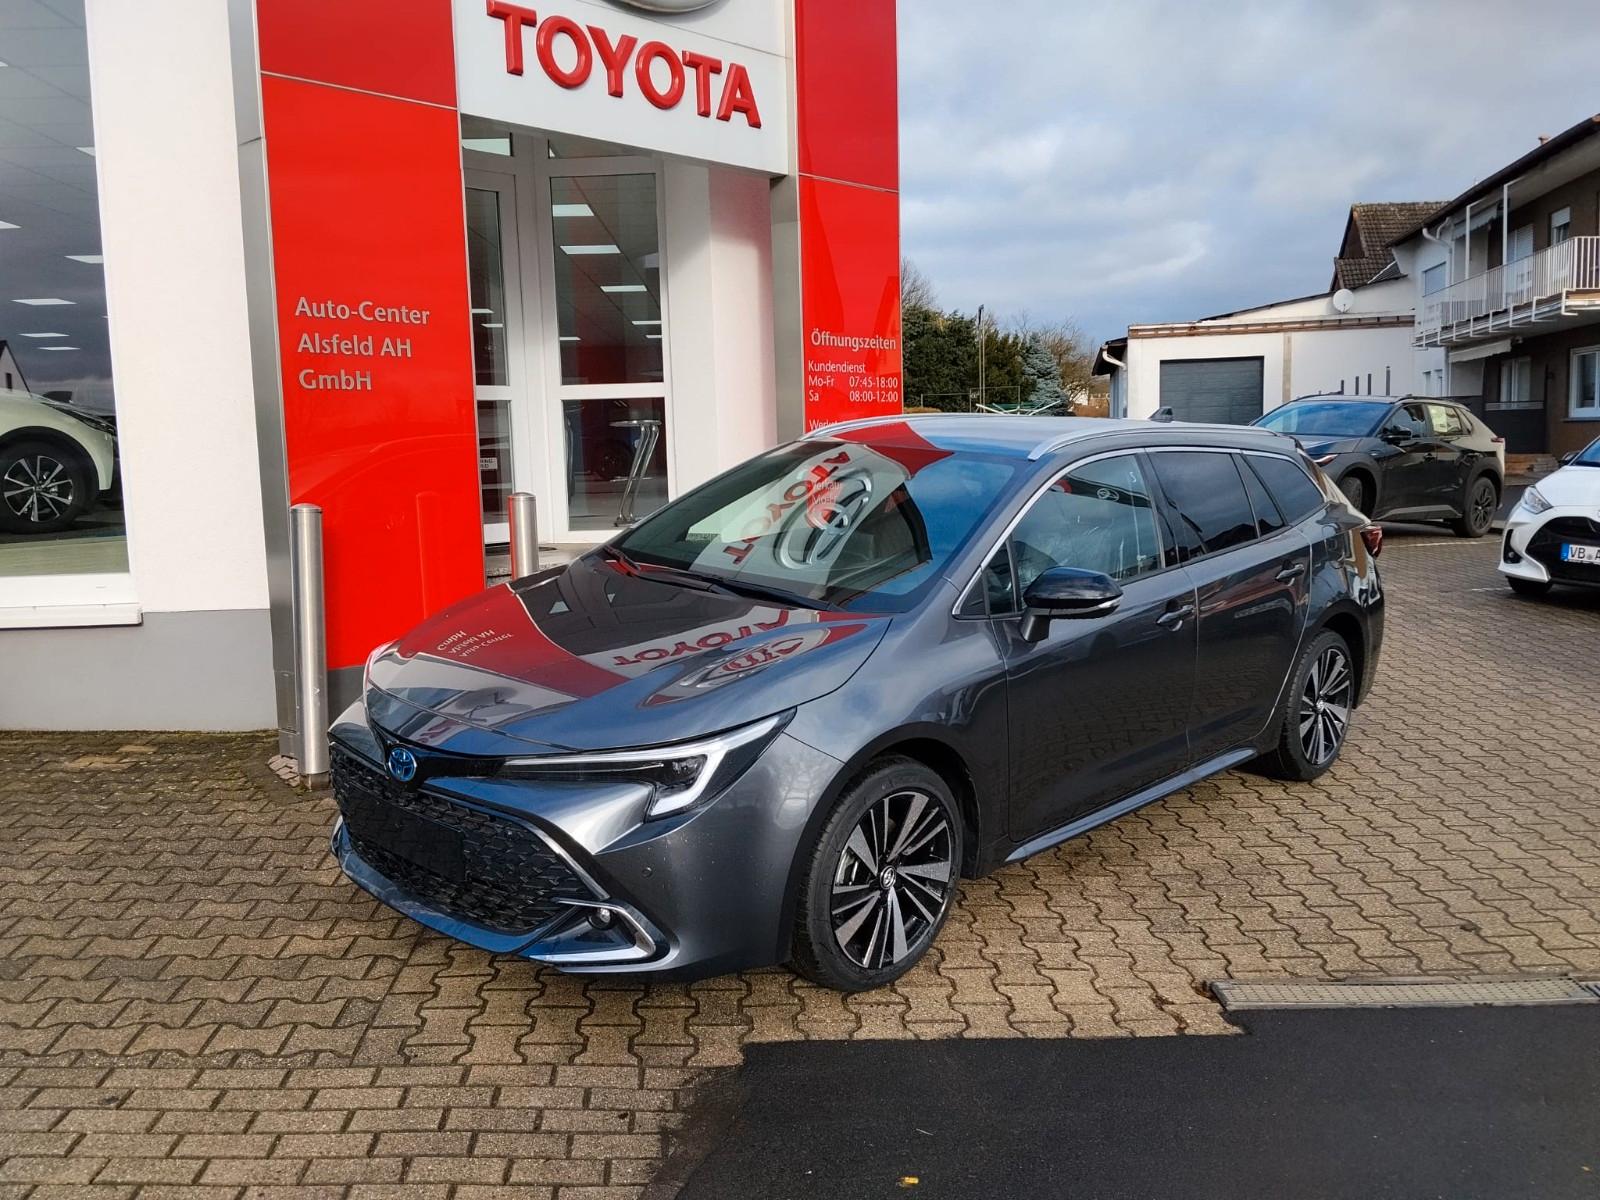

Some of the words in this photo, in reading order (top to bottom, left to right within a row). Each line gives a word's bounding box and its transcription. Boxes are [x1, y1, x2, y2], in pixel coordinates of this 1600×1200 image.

[486, 0, 761, 128] TOYOTA
[295, 297, 430, 324] Auto-Center
[298, 333, 373, 356] Alsfeld
[380, 337, 412, 358] AH
[811, 328, 897, 352] Öffnungszeiten
[808, 360, 867, 374] Kundendienst
[299, 369, 372, 390] GmbH
[808, 375, 835, 388] Mo-Fr
[849, 376, 898, 389] 07:45-18:00
[809, 389, 820, 402] Sa
[849, 391, 899, 403] 08:00-12:00
[1570, 546, 1586, 559] VB
